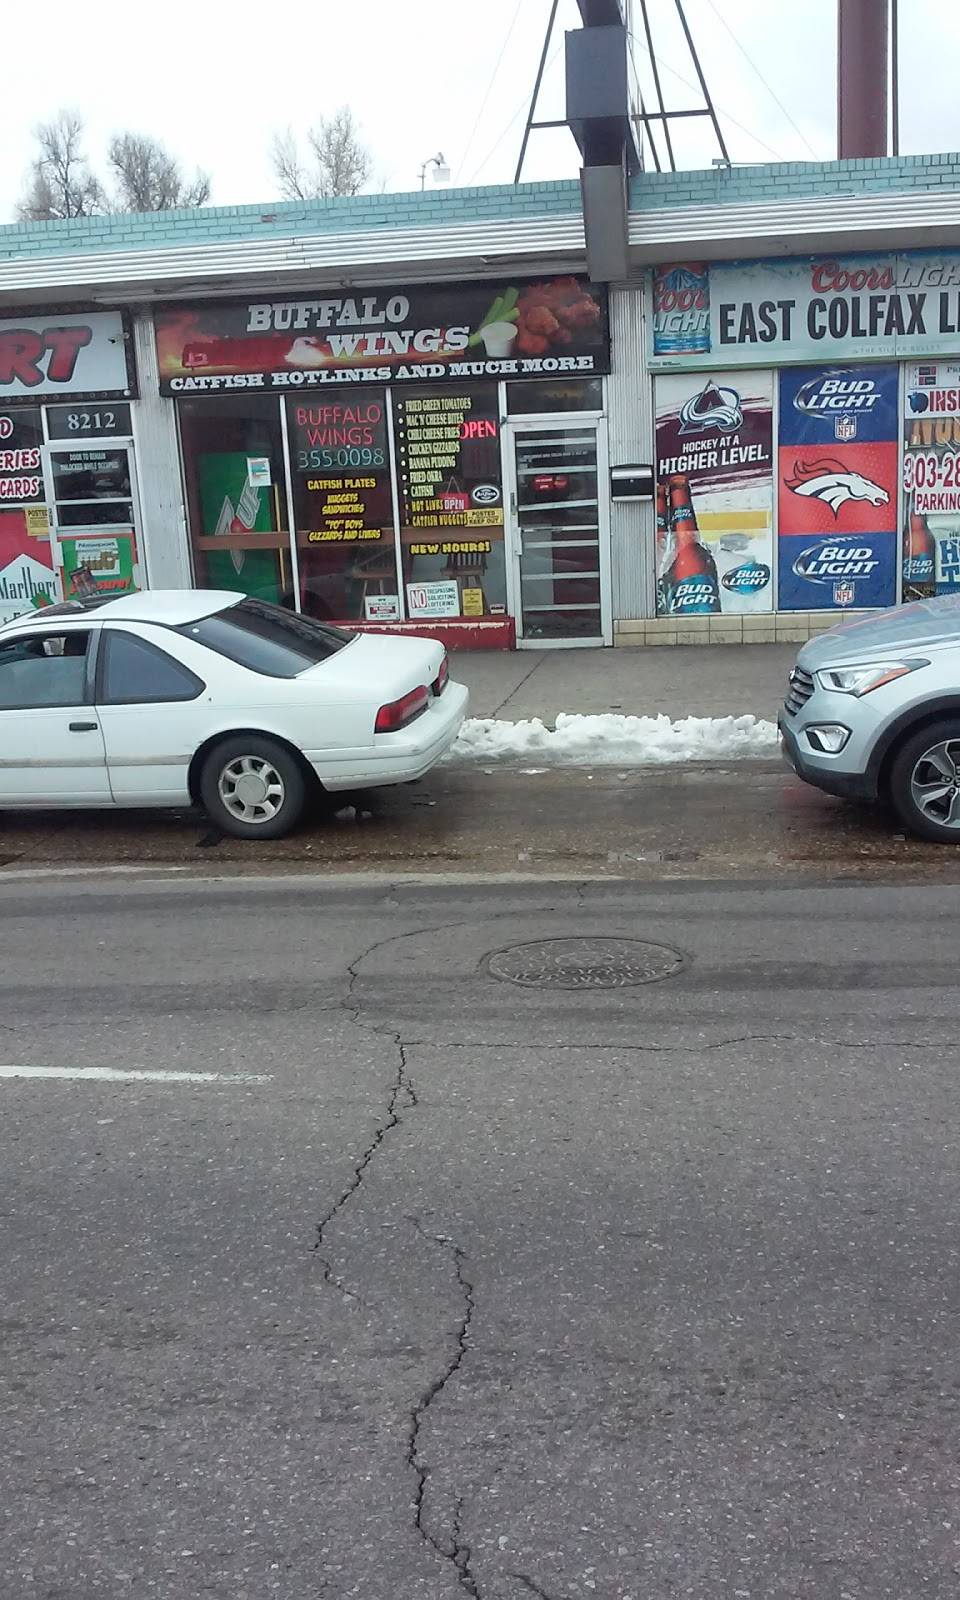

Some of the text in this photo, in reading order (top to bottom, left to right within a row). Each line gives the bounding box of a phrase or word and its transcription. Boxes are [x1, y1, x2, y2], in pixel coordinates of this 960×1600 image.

[811, 261, 894, 293] Coors
[246, 296, 411, 332] BUFFALO
[719, 300, 796, 344] EAST
[807, 293, 926, 340] COLFAX
[326, 326, 471, 358] WINGS
[170, 356, 594, 392] CATFISH HOTLINKS AND MUCH MORE
[819, 380, 875, 394] BUD
[405, 397, 472, 412] FRIED GREEN TOMATOES
[807, 394, 881, 409] LIGHT
[929, 390, 960, 412] INS
[67, 412, 116, 430] 8212
[296, 404, 381, 426] BUFFALO
[406, 415, 419, 427] MAC
[426, 413, 447, 425] CHEESE
[307, 427, 373, 446] WINGS
[423, 428, 444, 440] CHEESE
[459, 420, 496, 439] OPEN
[837, 424, 854, 437] NFL
[408, 443, 432, 455] CHICKEN
[682, 435, 740, 453] HOCKEY AT A
[299, 448, 384, 468] 355-0098
[660, 445, 769, 475] HIGHER LEVEL.
[308, 478, 376, 490] CATFISH PLATES
[410, 471, 426, 483] FRIED
[0, 477, 39, 497] CARDS
[411, 485, 434, 497] CATFISH
[327, 493, 358, 504] NUGGETS
[444, 499, 465, 510] OPEN
[411, 500, 424, 512] HOT
[412, 514, 438, 527] CATFISH
[411, 541, 490, 554] NEW HOURS!
[818, 548, 873, 561] BUD
[736, 569, 765, 579] BUD
[806, 561, 879, 575] LIGHT
[729, 576, 769, 586] LIGHT
[676, 584, 713, 596] BUD
[836, 591, 853, 602] NFL
[410, 590, 427, 608] NO
[671, 594, 717, 610] LIGHT
